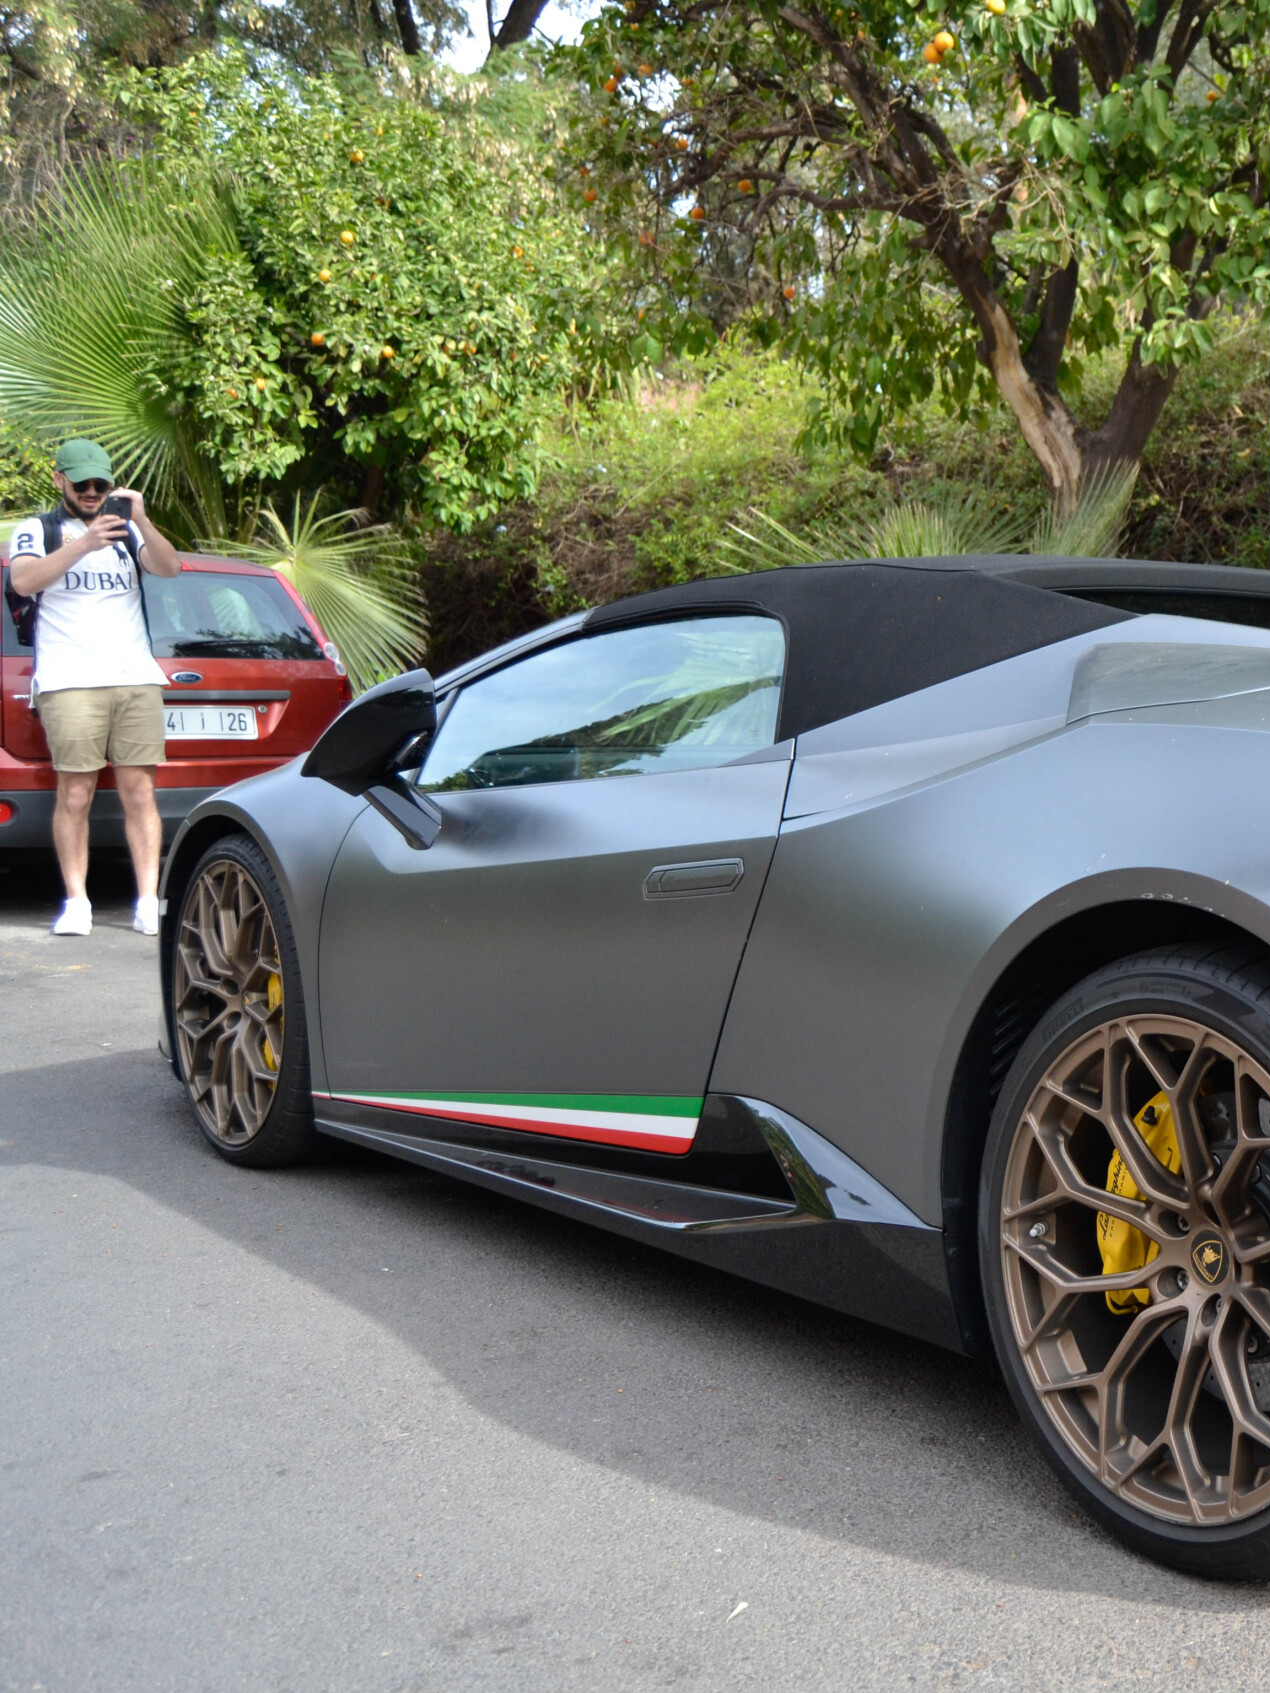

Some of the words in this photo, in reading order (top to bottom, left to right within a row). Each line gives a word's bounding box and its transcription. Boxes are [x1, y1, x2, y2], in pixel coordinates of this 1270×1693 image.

[17, 532, 34, 551] 2
[64, 571, 134, 590] DUBAI
[227, 712, 247, 731] 26
